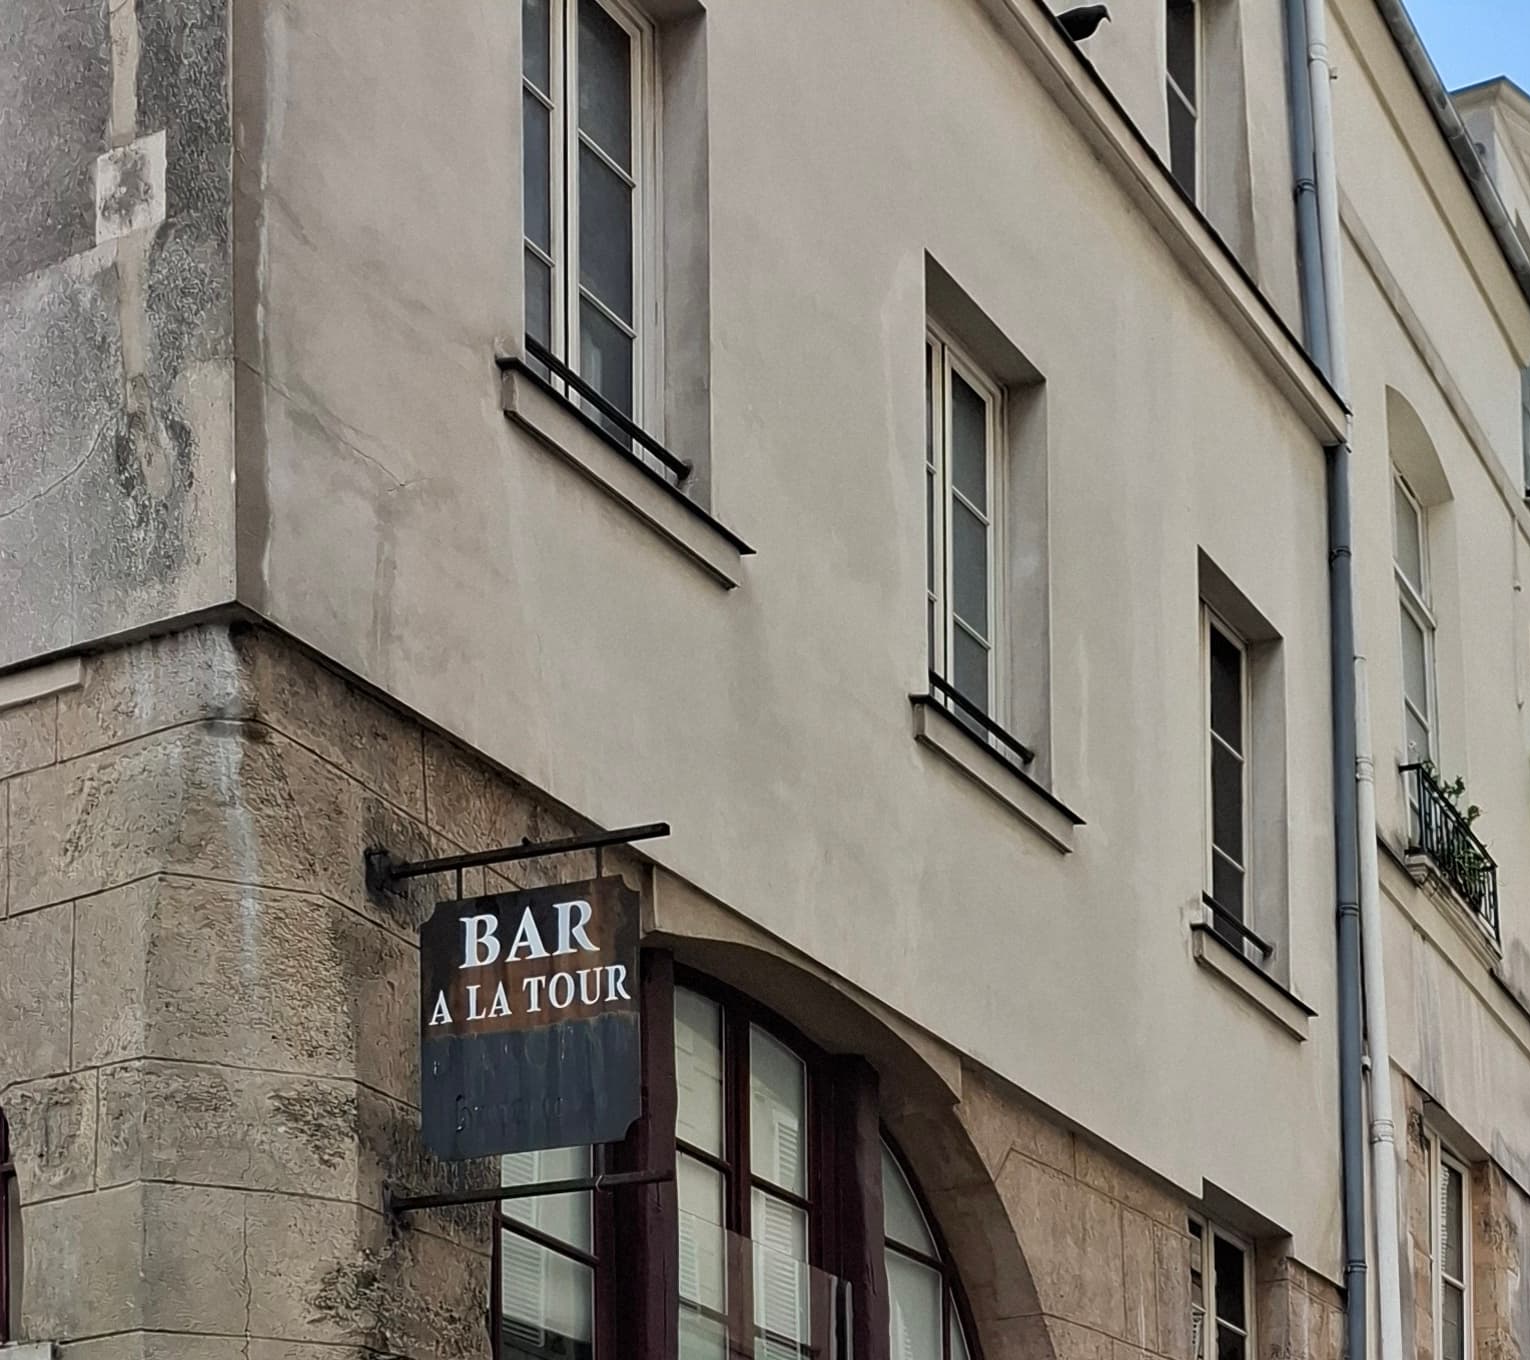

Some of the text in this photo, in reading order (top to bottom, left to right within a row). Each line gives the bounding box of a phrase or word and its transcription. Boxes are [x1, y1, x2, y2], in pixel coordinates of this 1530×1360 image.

[458, 900, 600, 969] BAR
[428, 965, 631, 1026] A LA TOUR
